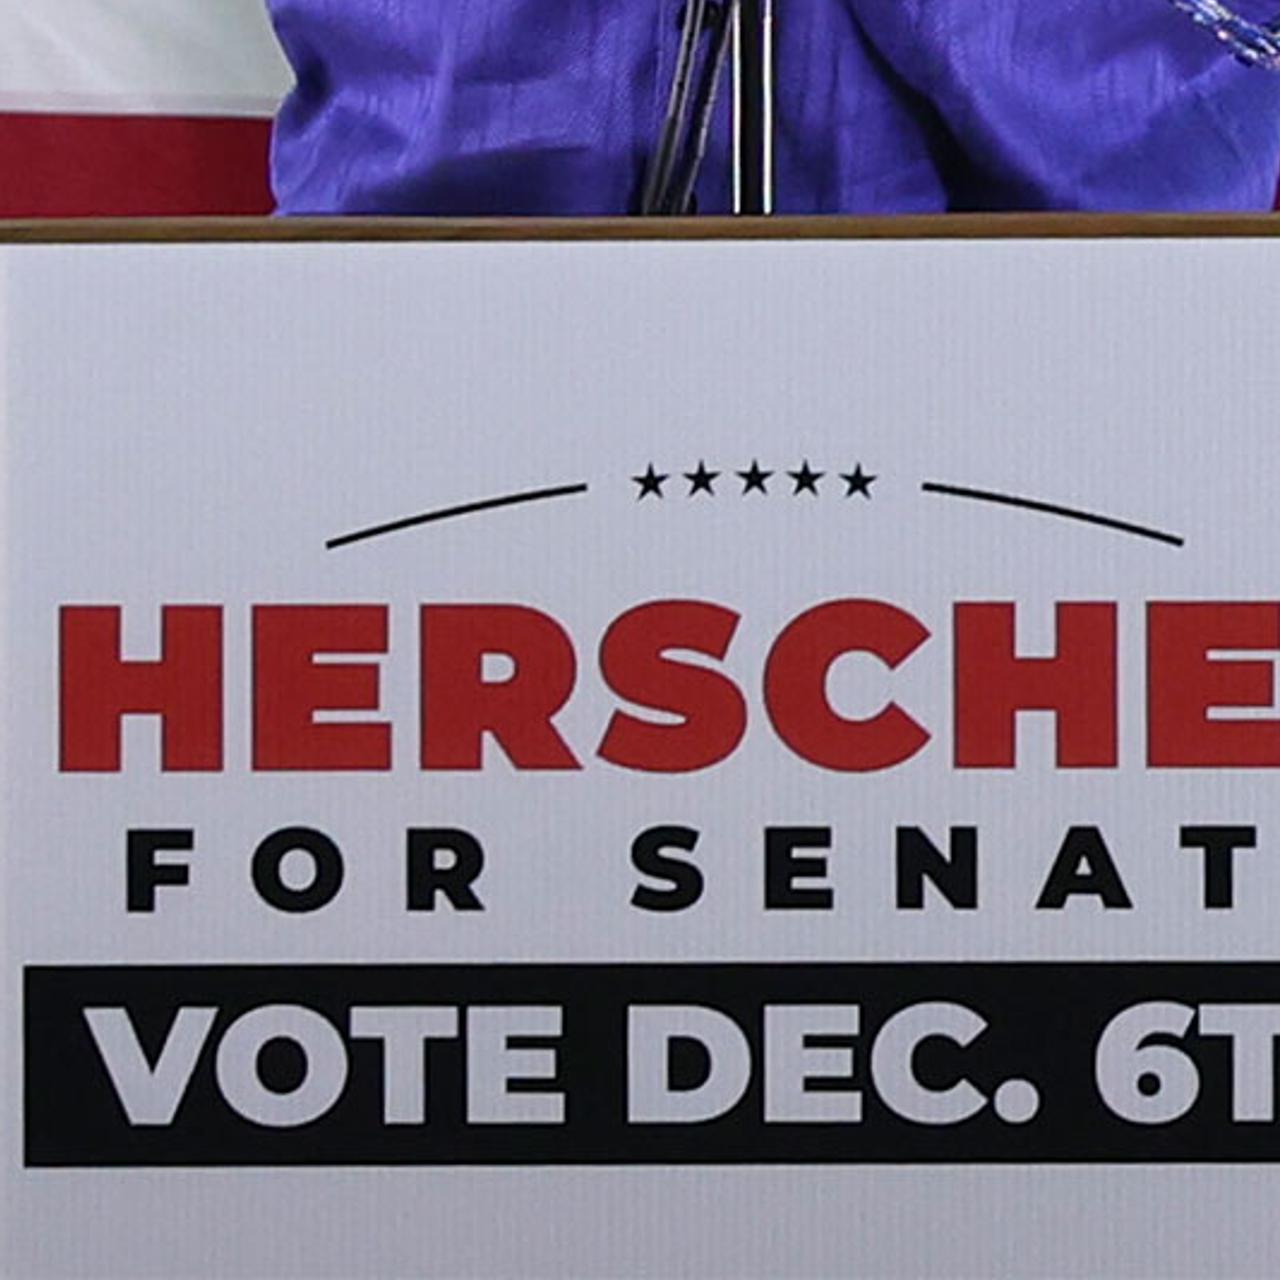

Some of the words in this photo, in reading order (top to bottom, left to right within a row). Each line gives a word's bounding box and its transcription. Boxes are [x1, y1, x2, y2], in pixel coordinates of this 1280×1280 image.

[58, 599, 1280, 773] HERSCHE
[124, 825, 486, 914] FOR
[629, 824, 1257, 913] SENAT
[82, 1003, 566, 1127] VOTE
[626, 1000, 1040, 1125] DEC.
[1094, 1000, 1280, 1125] 6T
